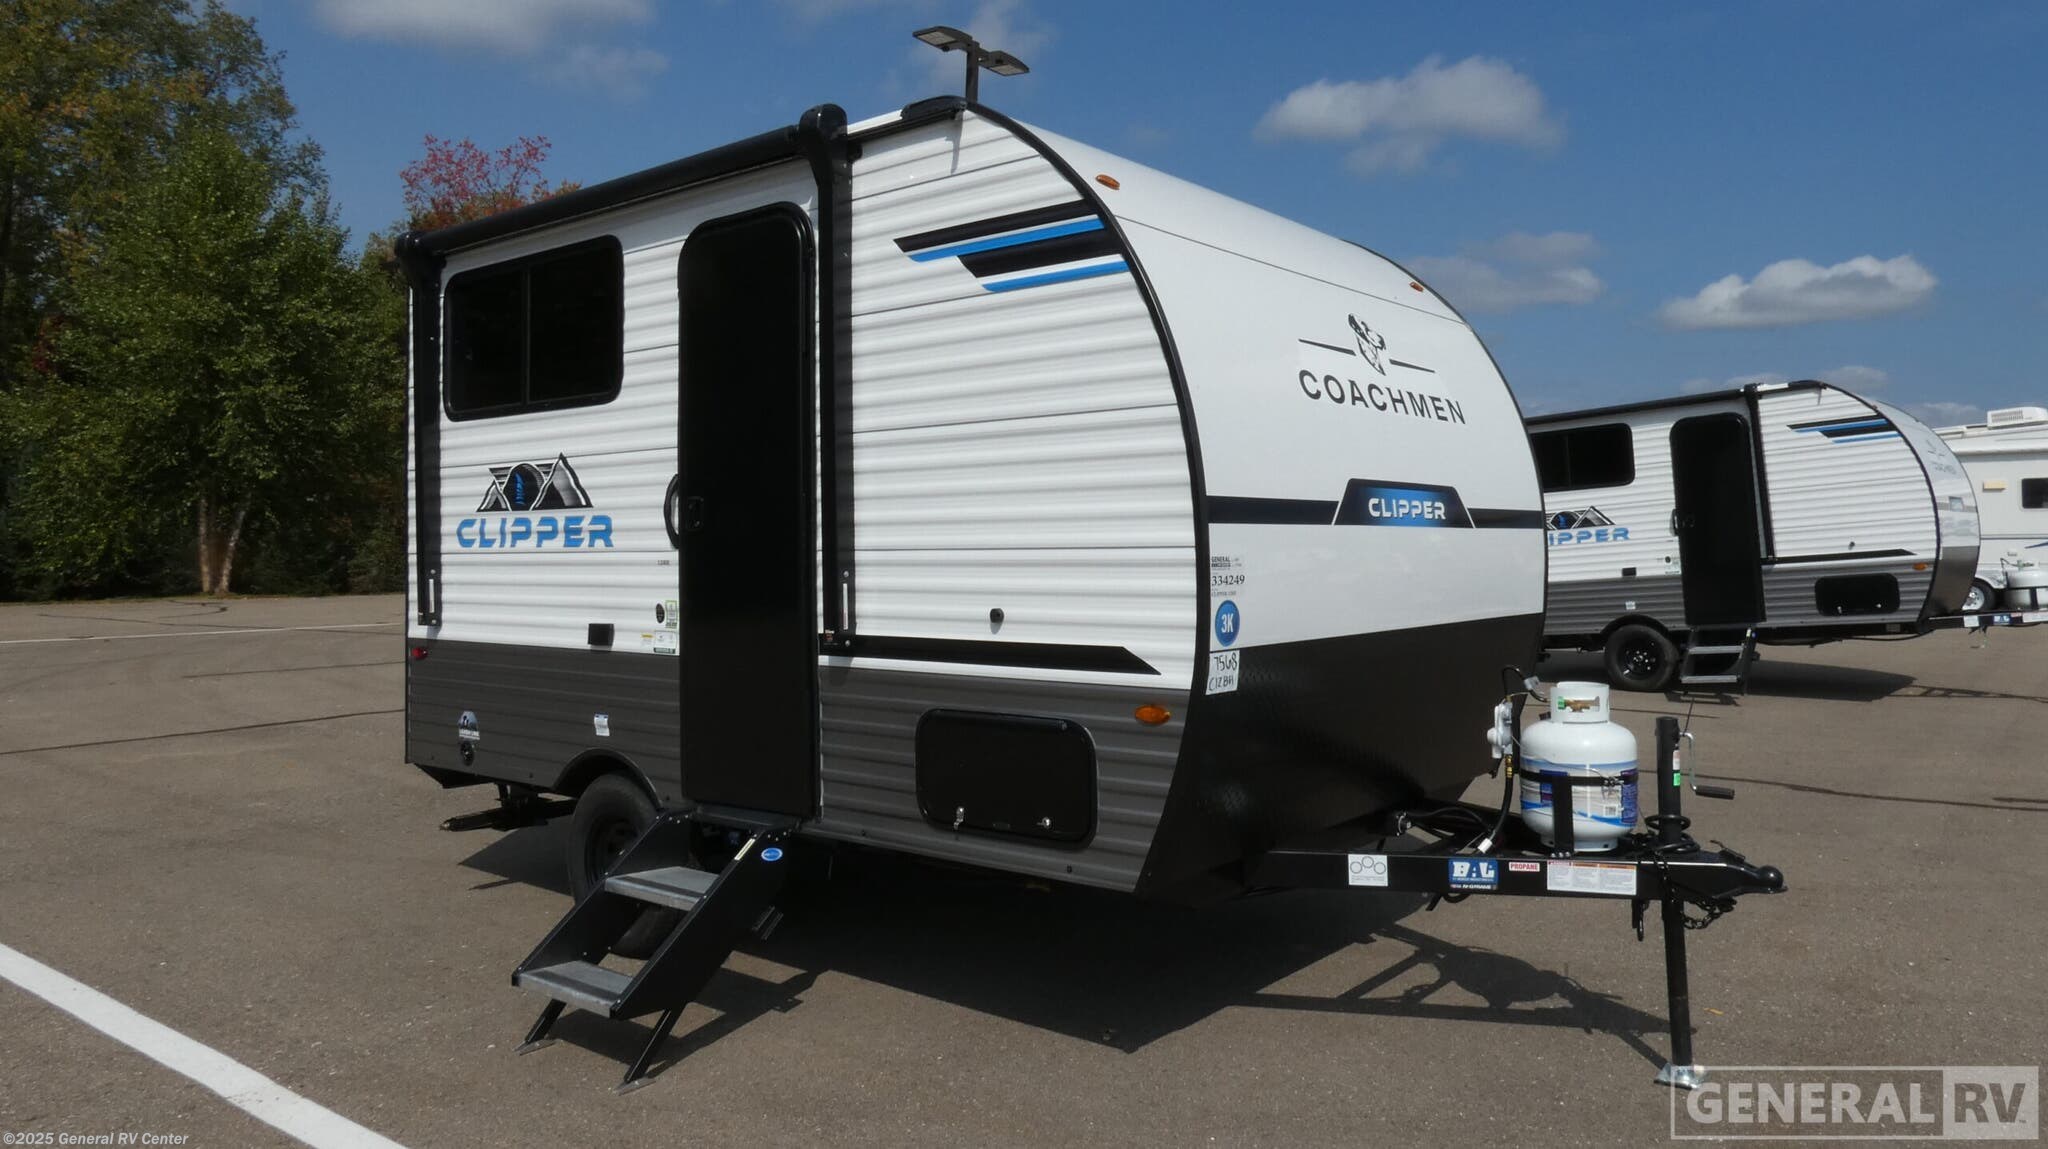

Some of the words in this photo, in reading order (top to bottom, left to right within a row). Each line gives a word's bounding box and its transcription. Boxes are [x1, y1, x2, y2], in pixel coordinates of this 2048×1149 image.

[1299, 369, 1466, 425] COACHMEN
[1368, 498, 1446, 519] CLIPPER
[456, 515, 614, 548] CLIPPER
[1549, 527, 1630, 546] IPPER
[1212, 574, 1245, 586] 334249
[1221, 613, 1234, 633] 3K
[1510, 863, 1538, 871] PROPANE
